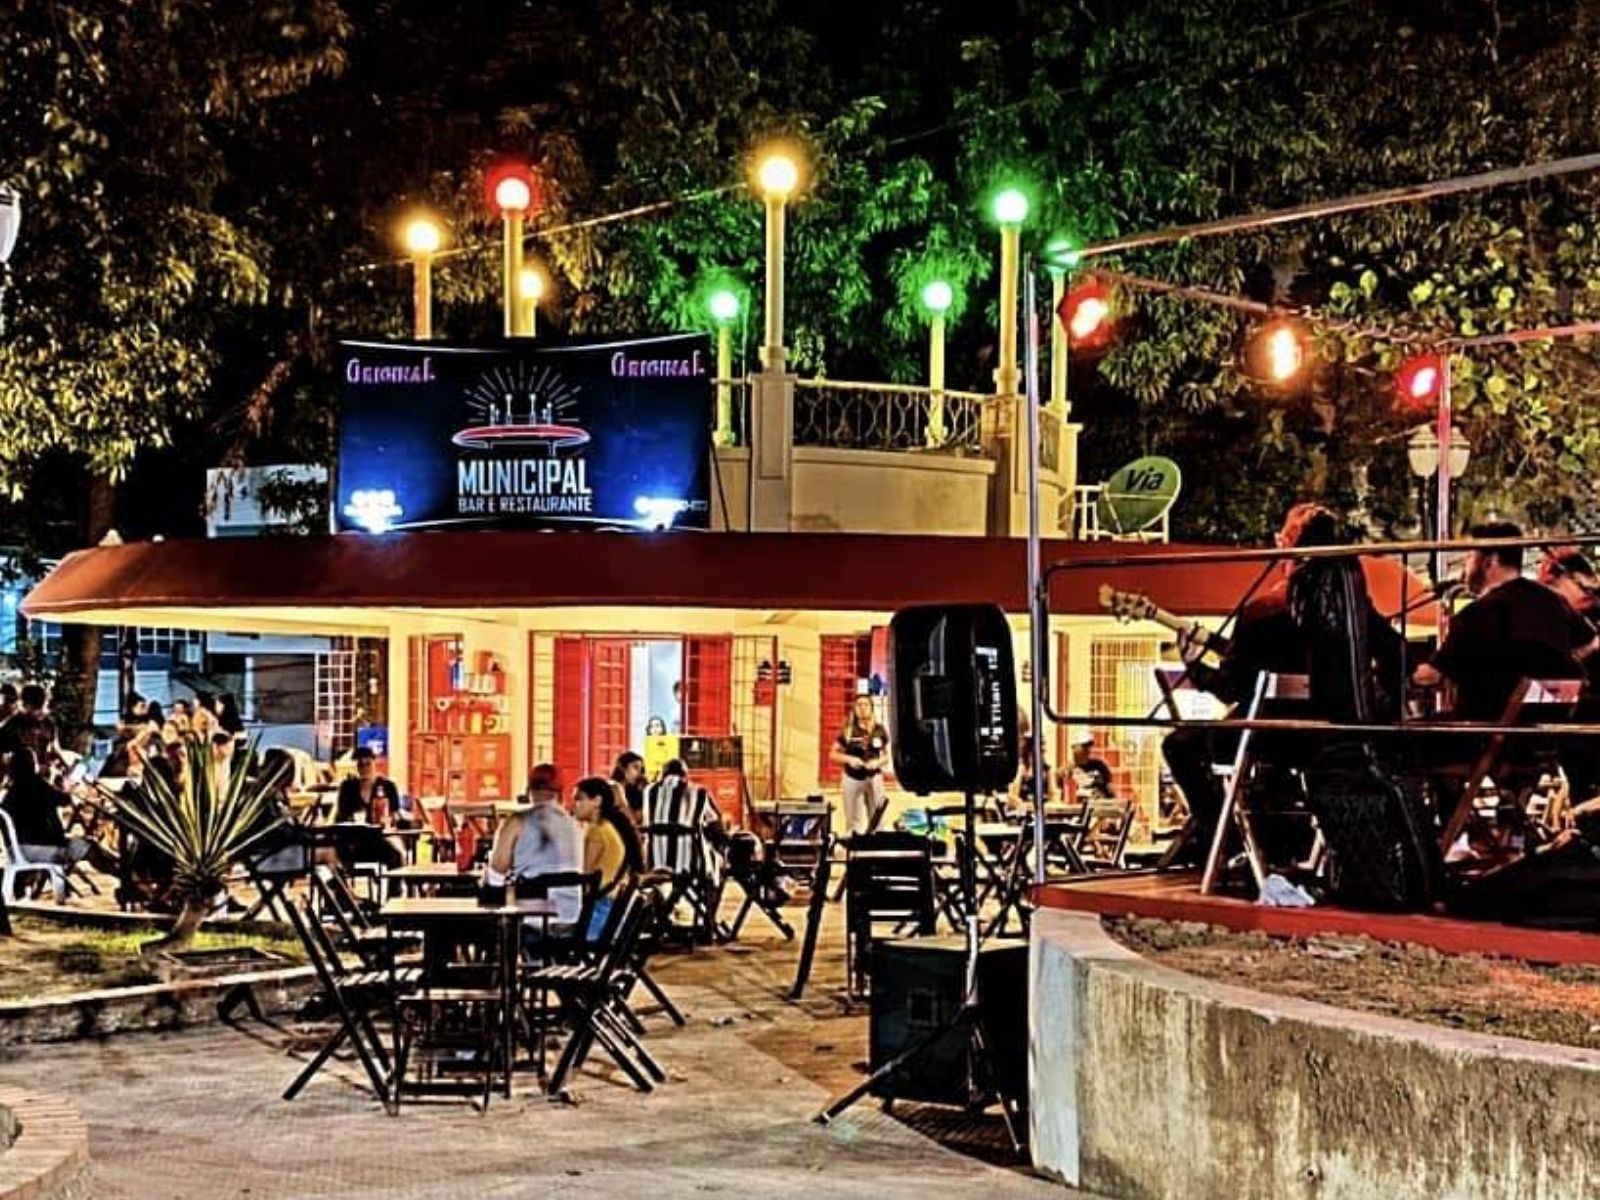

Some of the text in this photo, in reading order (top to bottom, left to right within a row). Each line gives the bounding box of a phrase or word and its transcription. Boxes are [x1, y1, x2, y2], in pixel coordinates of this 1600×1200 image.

[458, 459, 592, 494] MUNICIPAL
[1126, 467, 1164, 492] Via
[458, 496, 592, 512] BAR E RESTAURANTE
